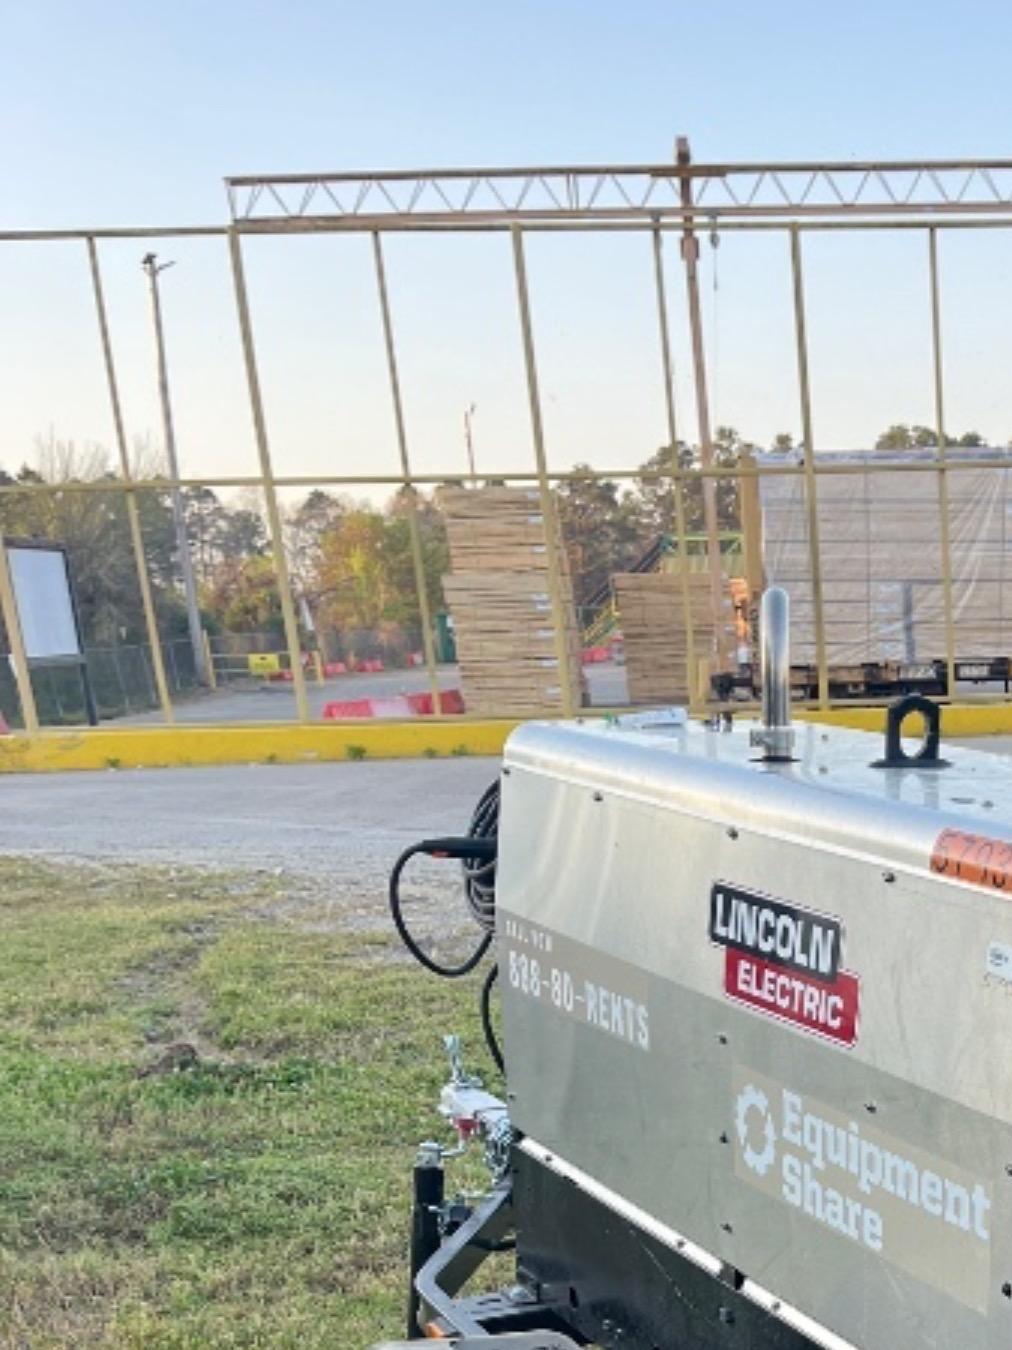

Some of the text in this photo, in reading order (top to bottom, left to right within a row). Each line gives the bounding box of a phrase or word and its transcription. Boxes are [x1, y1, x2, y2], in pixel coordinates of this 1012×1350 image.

[714, 893, 835, 974] LINCOLN
[736, 959, 845, 1029] ELECTRIC
[781, 1088, 991, 1240] Equipment
[781, 1153, 884, 1250] Share
